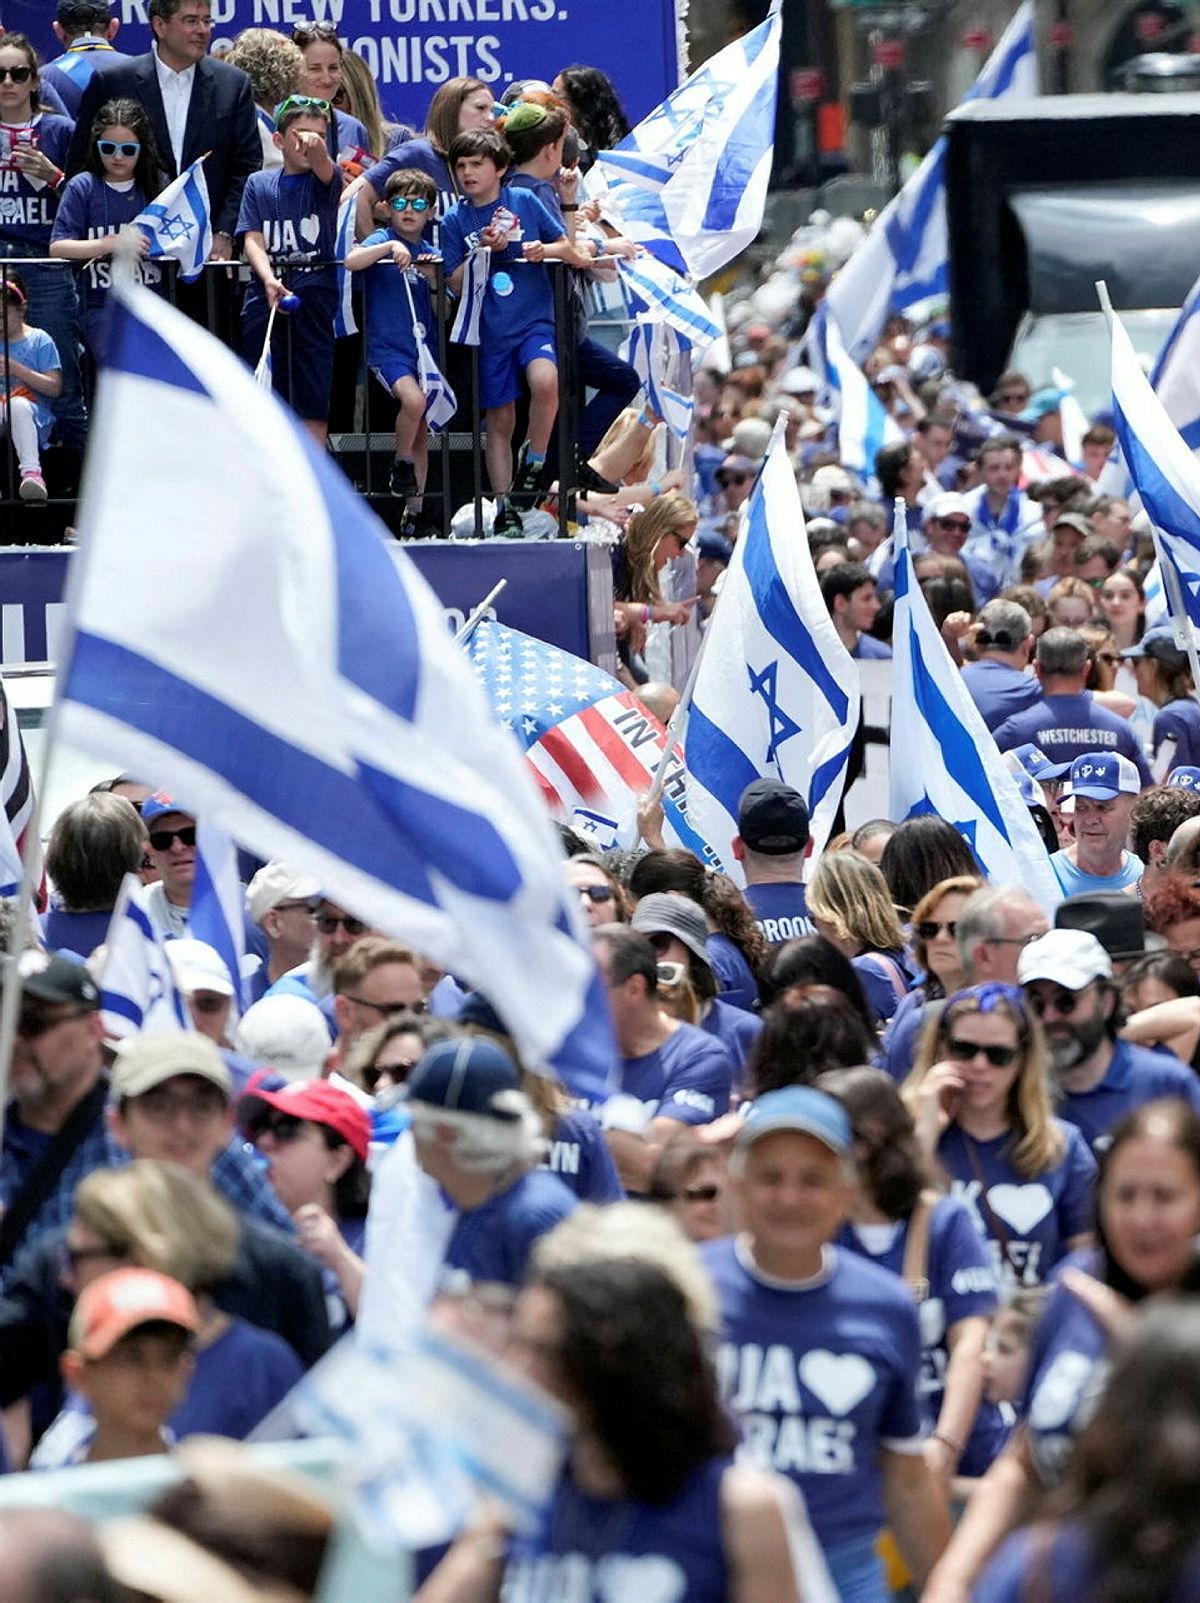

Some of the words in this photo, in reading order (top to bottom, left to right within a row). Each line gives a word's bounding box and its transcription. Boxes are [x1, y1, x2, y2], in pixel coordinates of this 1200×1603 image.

[340, 36, 514, 83] ONISTS.
[614, 710, 658, 749] IN
[1037, 728, 1118, 747] WESTCHESTER
